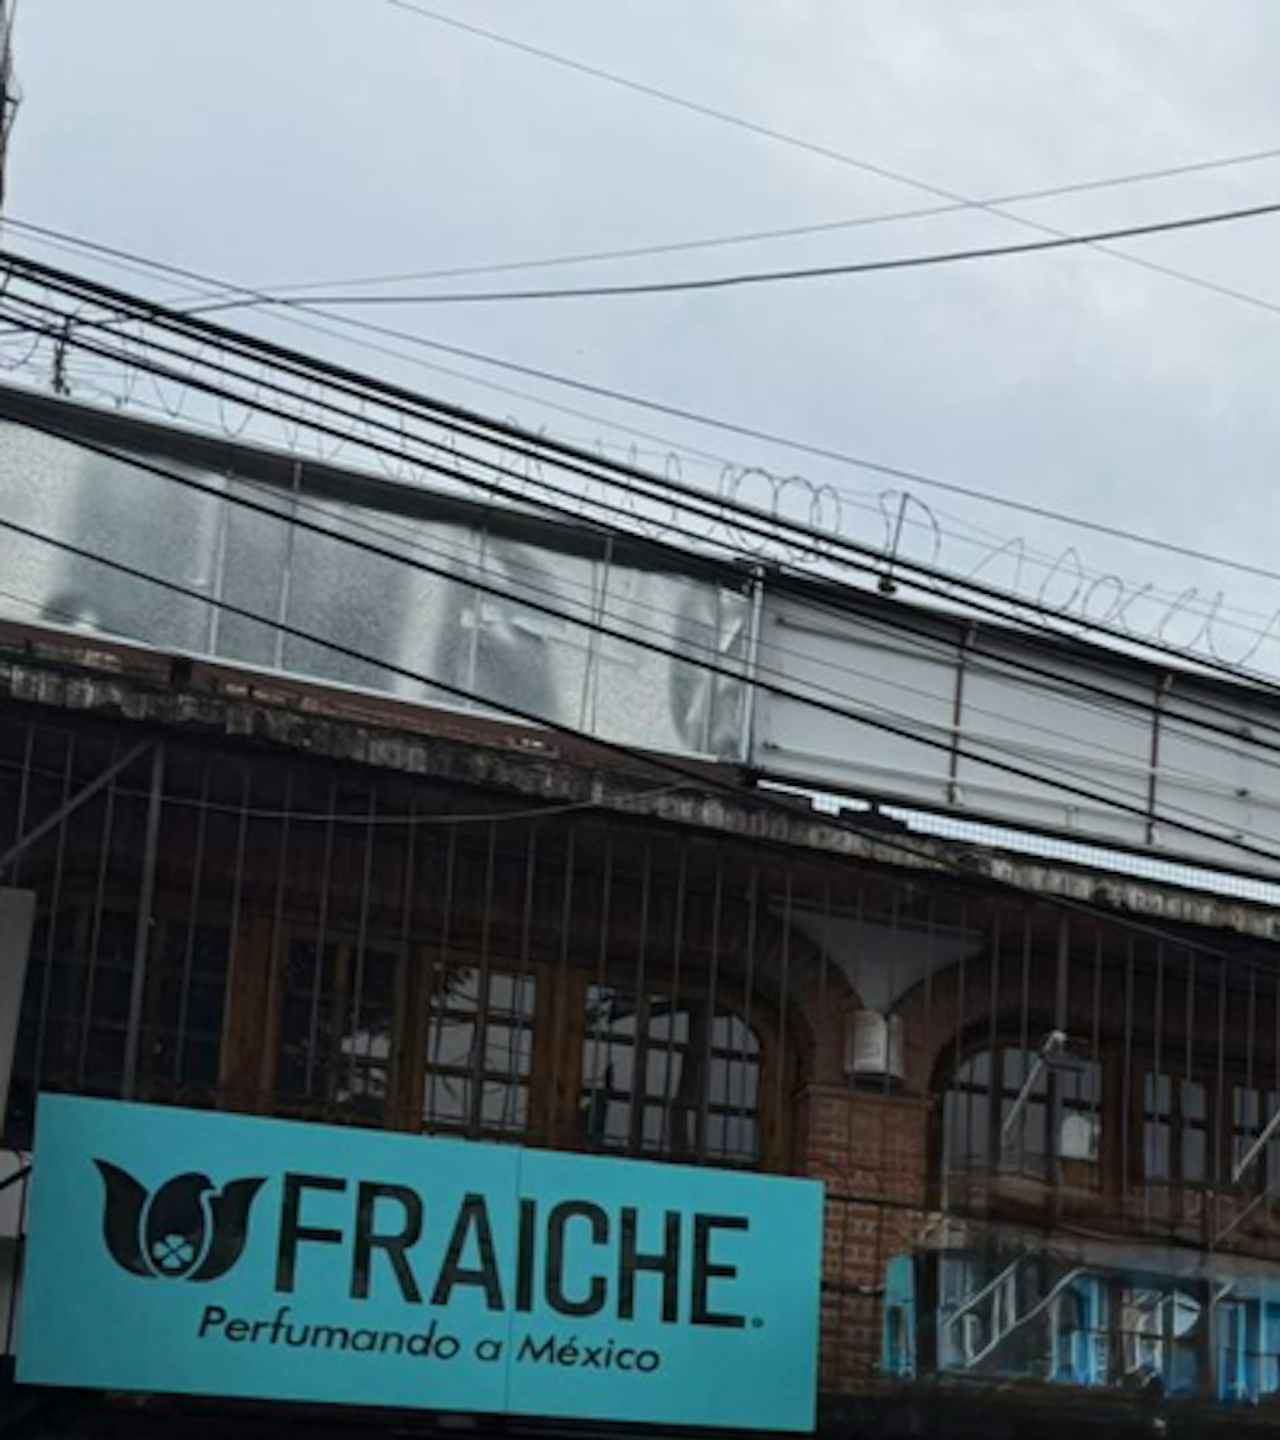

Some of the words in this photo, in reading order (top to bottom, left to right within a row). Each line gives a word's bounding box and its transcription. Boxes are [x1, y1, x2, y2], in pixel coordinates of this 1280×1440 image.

[273, 1172, 752, 1328] FRAICHE
[197, 1305, 461, 1361] Perfumando
[474, 1339, 504, 1362] a
[517, 1335, 662, 1375] México
